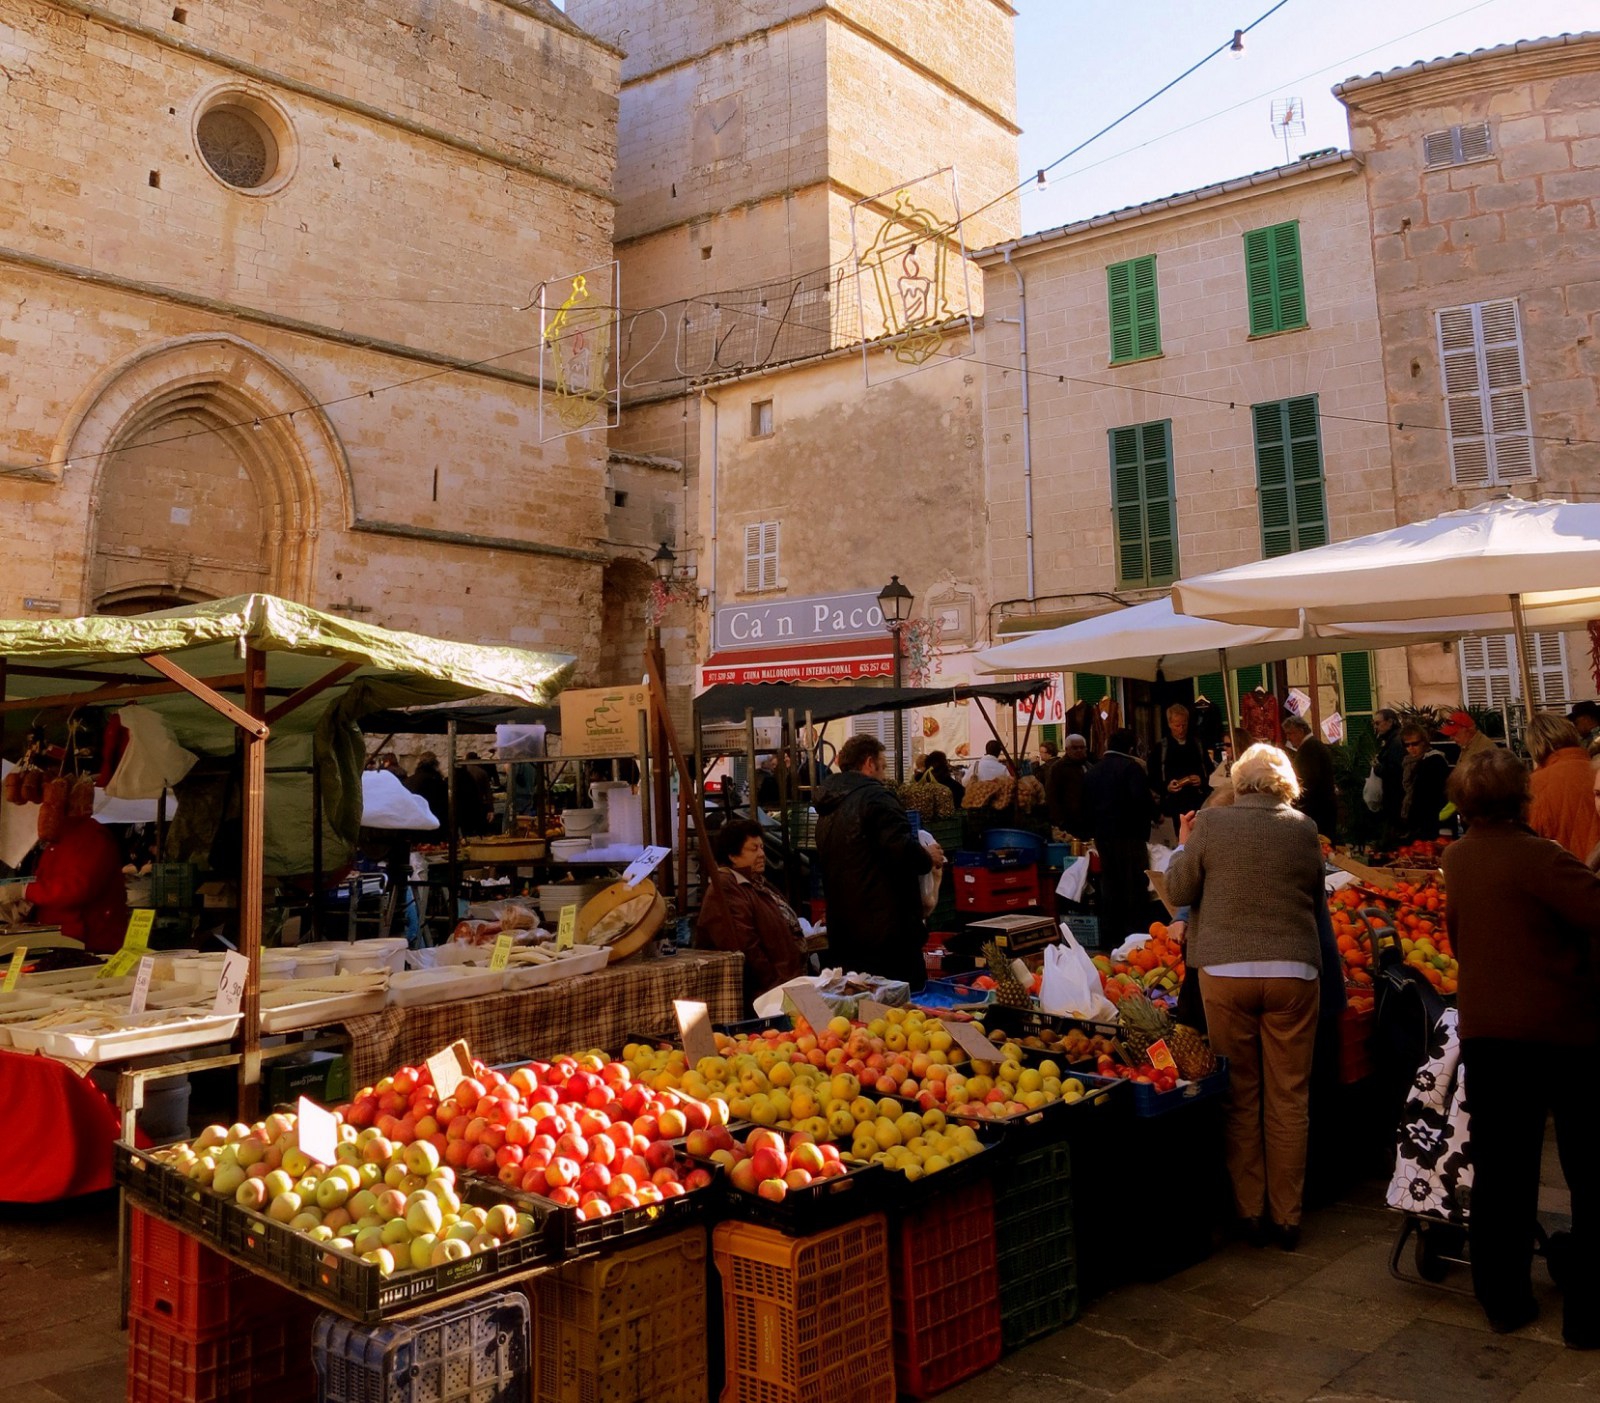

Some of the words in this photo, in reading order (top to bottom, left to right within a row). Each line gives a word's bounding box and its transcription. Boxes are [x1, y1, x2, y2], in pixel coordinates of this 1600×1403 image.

[812, 604, 882, 633] Paco
[743, 671, 760, 680] CUINA
[761, 668, 800, 679] MALLORQUINA
[805, 664, 852, 676] INTERNACIONAL
